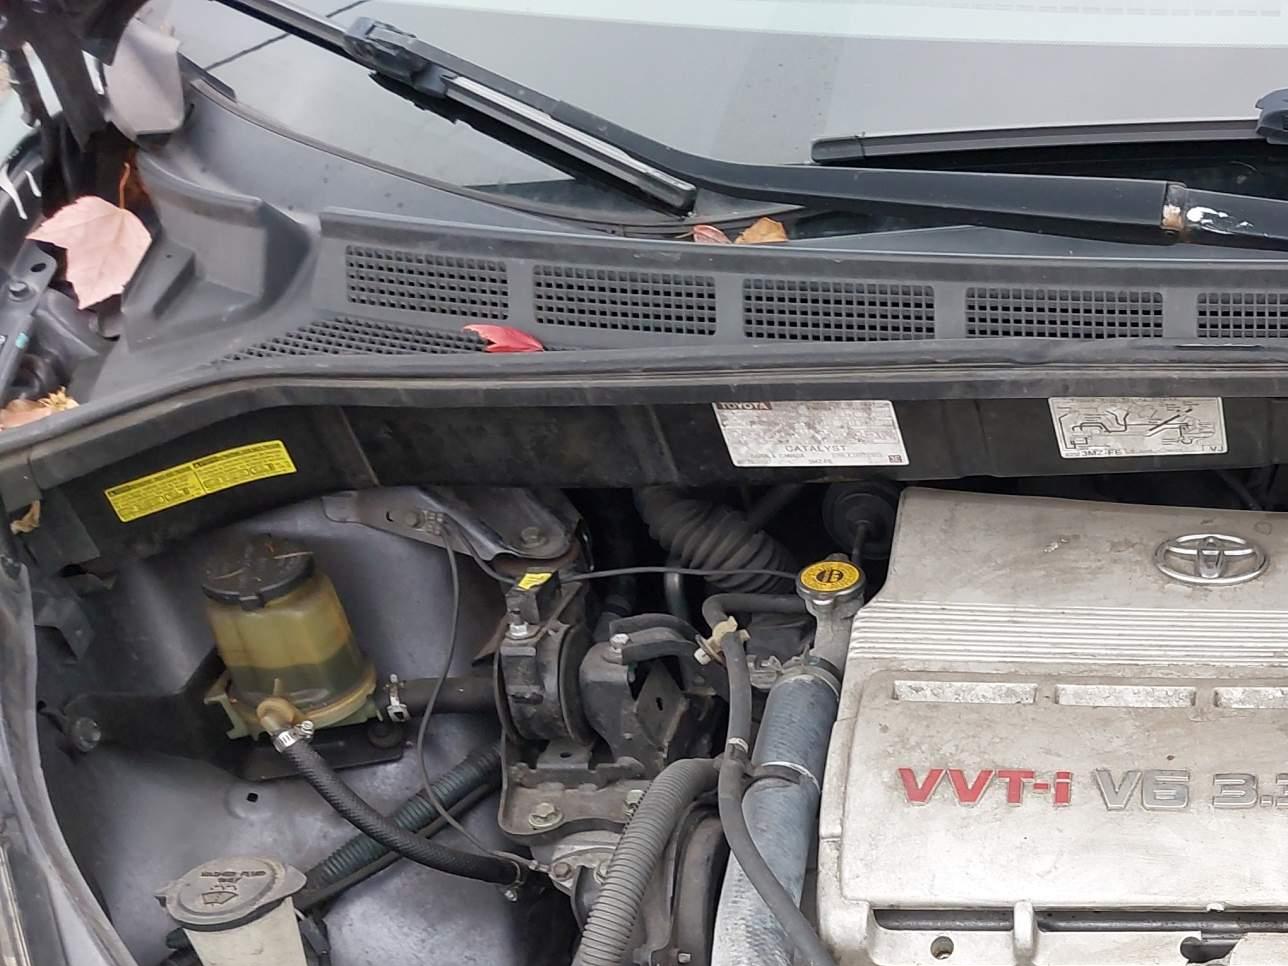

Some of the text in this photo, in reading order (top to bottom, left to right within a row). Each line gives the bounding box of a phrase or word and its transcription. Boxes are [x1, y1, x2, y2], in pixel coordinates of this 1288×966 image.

[719, 402, 768, 410] TOYOTA
[898, 767, 1074, 808] VVT-i
[1096, 768, 1191, 811] V6
